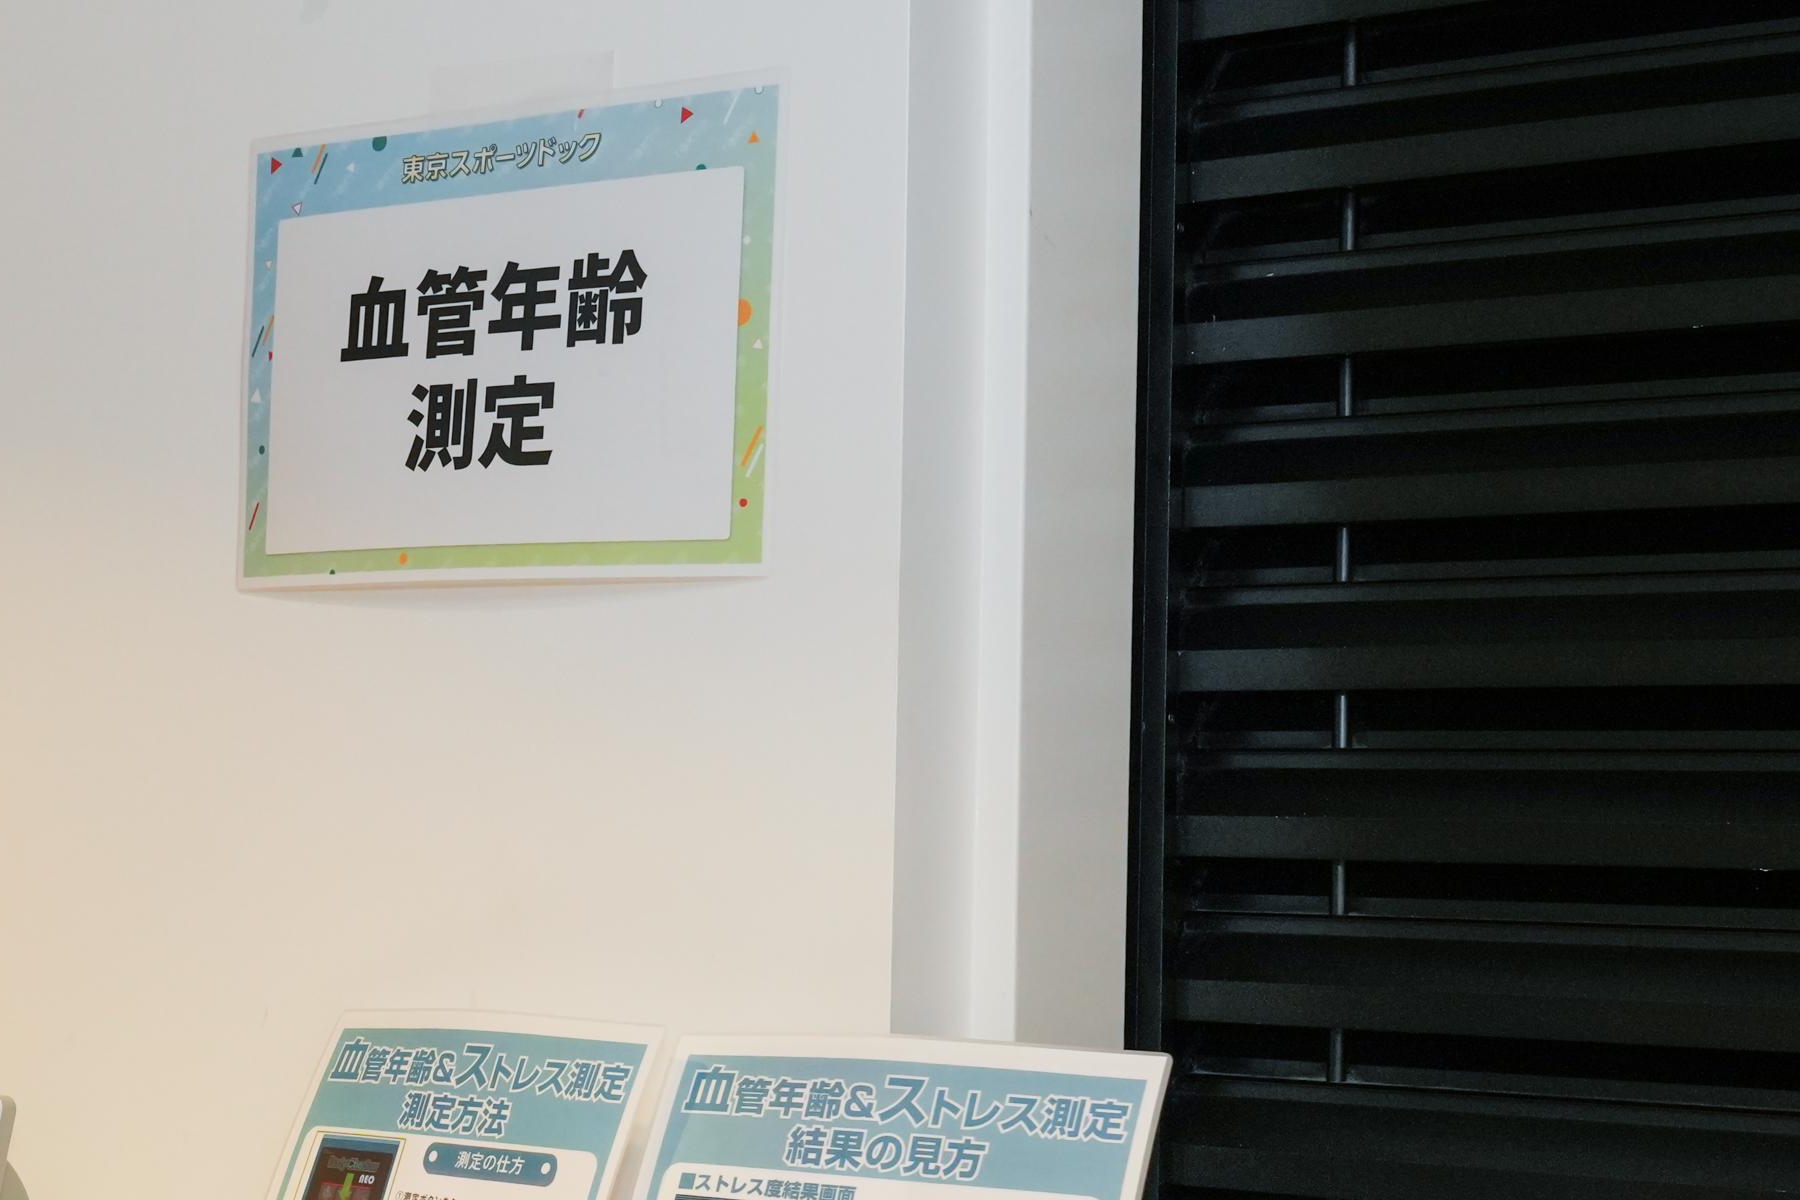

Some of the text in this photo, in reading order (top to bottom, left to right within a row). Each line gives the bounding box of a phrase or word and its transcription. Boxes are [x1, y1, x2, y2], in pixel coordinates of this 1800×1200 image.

[401, 132, 602, 185] 東京スポーツドック
[340, 249, 647, 362] 血管年齢
[405, 375, 555, 472] 測定
[328, 1036, 635, 1104] 血管年齢&ストレス測定
[397, 1090, 512, 1138] 測定方法
[681, 1063, 1135, 1143] 血管年齢&ストレス測定
[454, 1150, 525, 1176] 測定の仕方
[784, 1123, 988, 1182] 結果の見方
